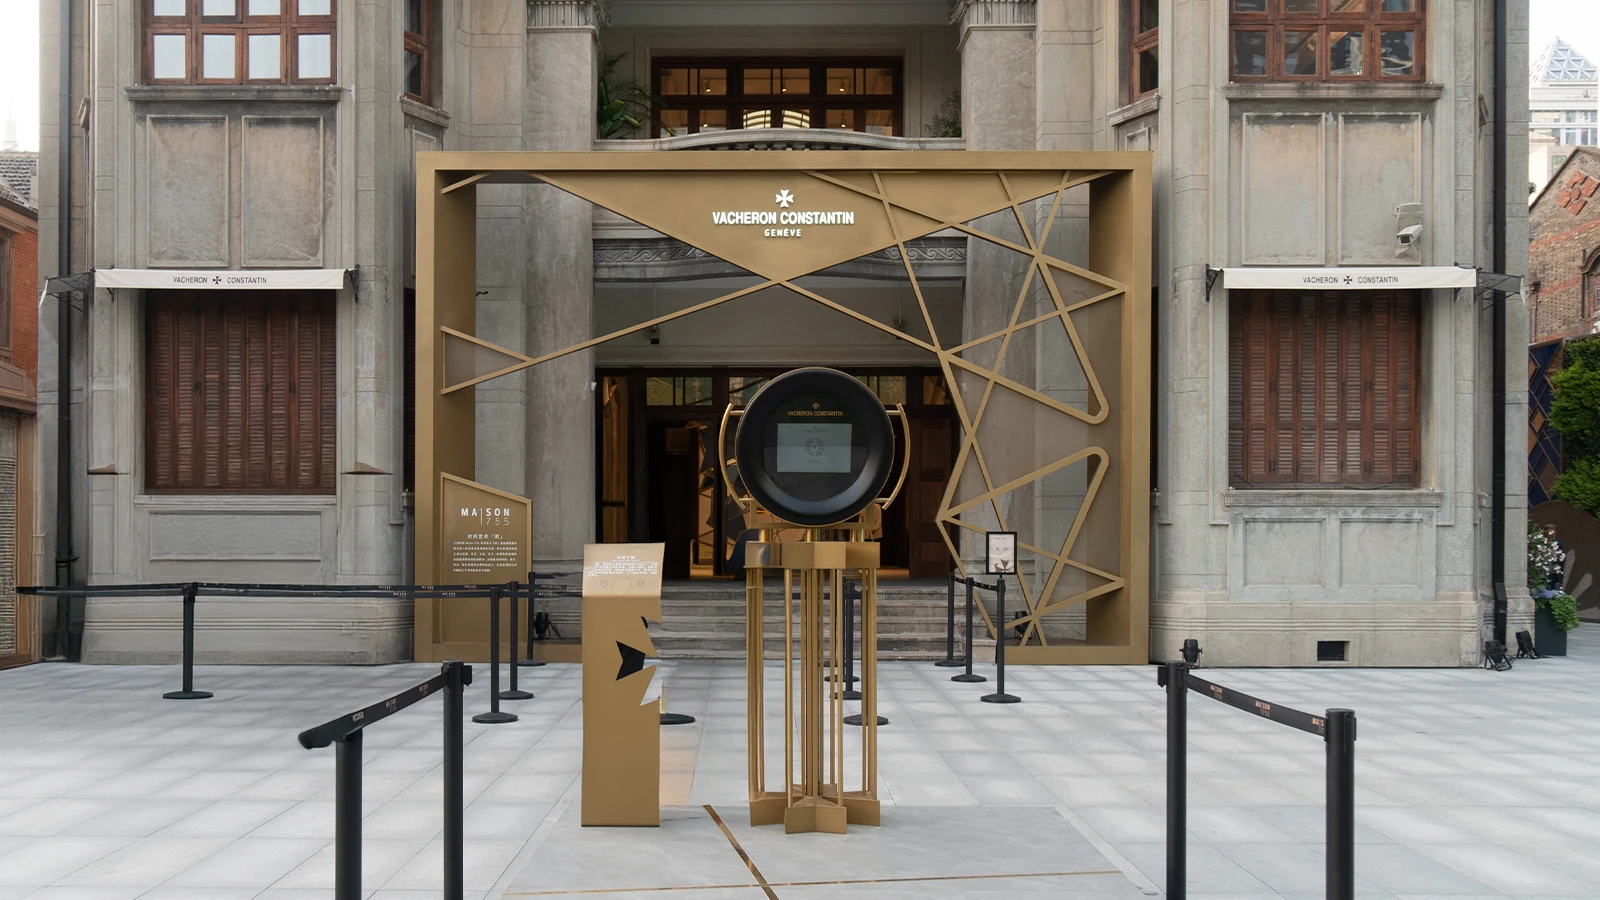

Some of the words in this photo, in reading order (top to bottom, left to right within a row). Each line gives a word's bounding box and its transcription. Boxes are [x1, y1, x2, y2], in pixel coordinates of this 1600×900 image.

[712, 211, 777, 225] VACHERON
[780, 211, 855, 225] CONSTANTIN
[173, 276, 208, 284] VACHERON
[226, 276, 267, 284] CONSTANTIN
[1303, 276, 1339, 284] VACHERON
[1357, 276, 1399, 284] CONSTANTIN
